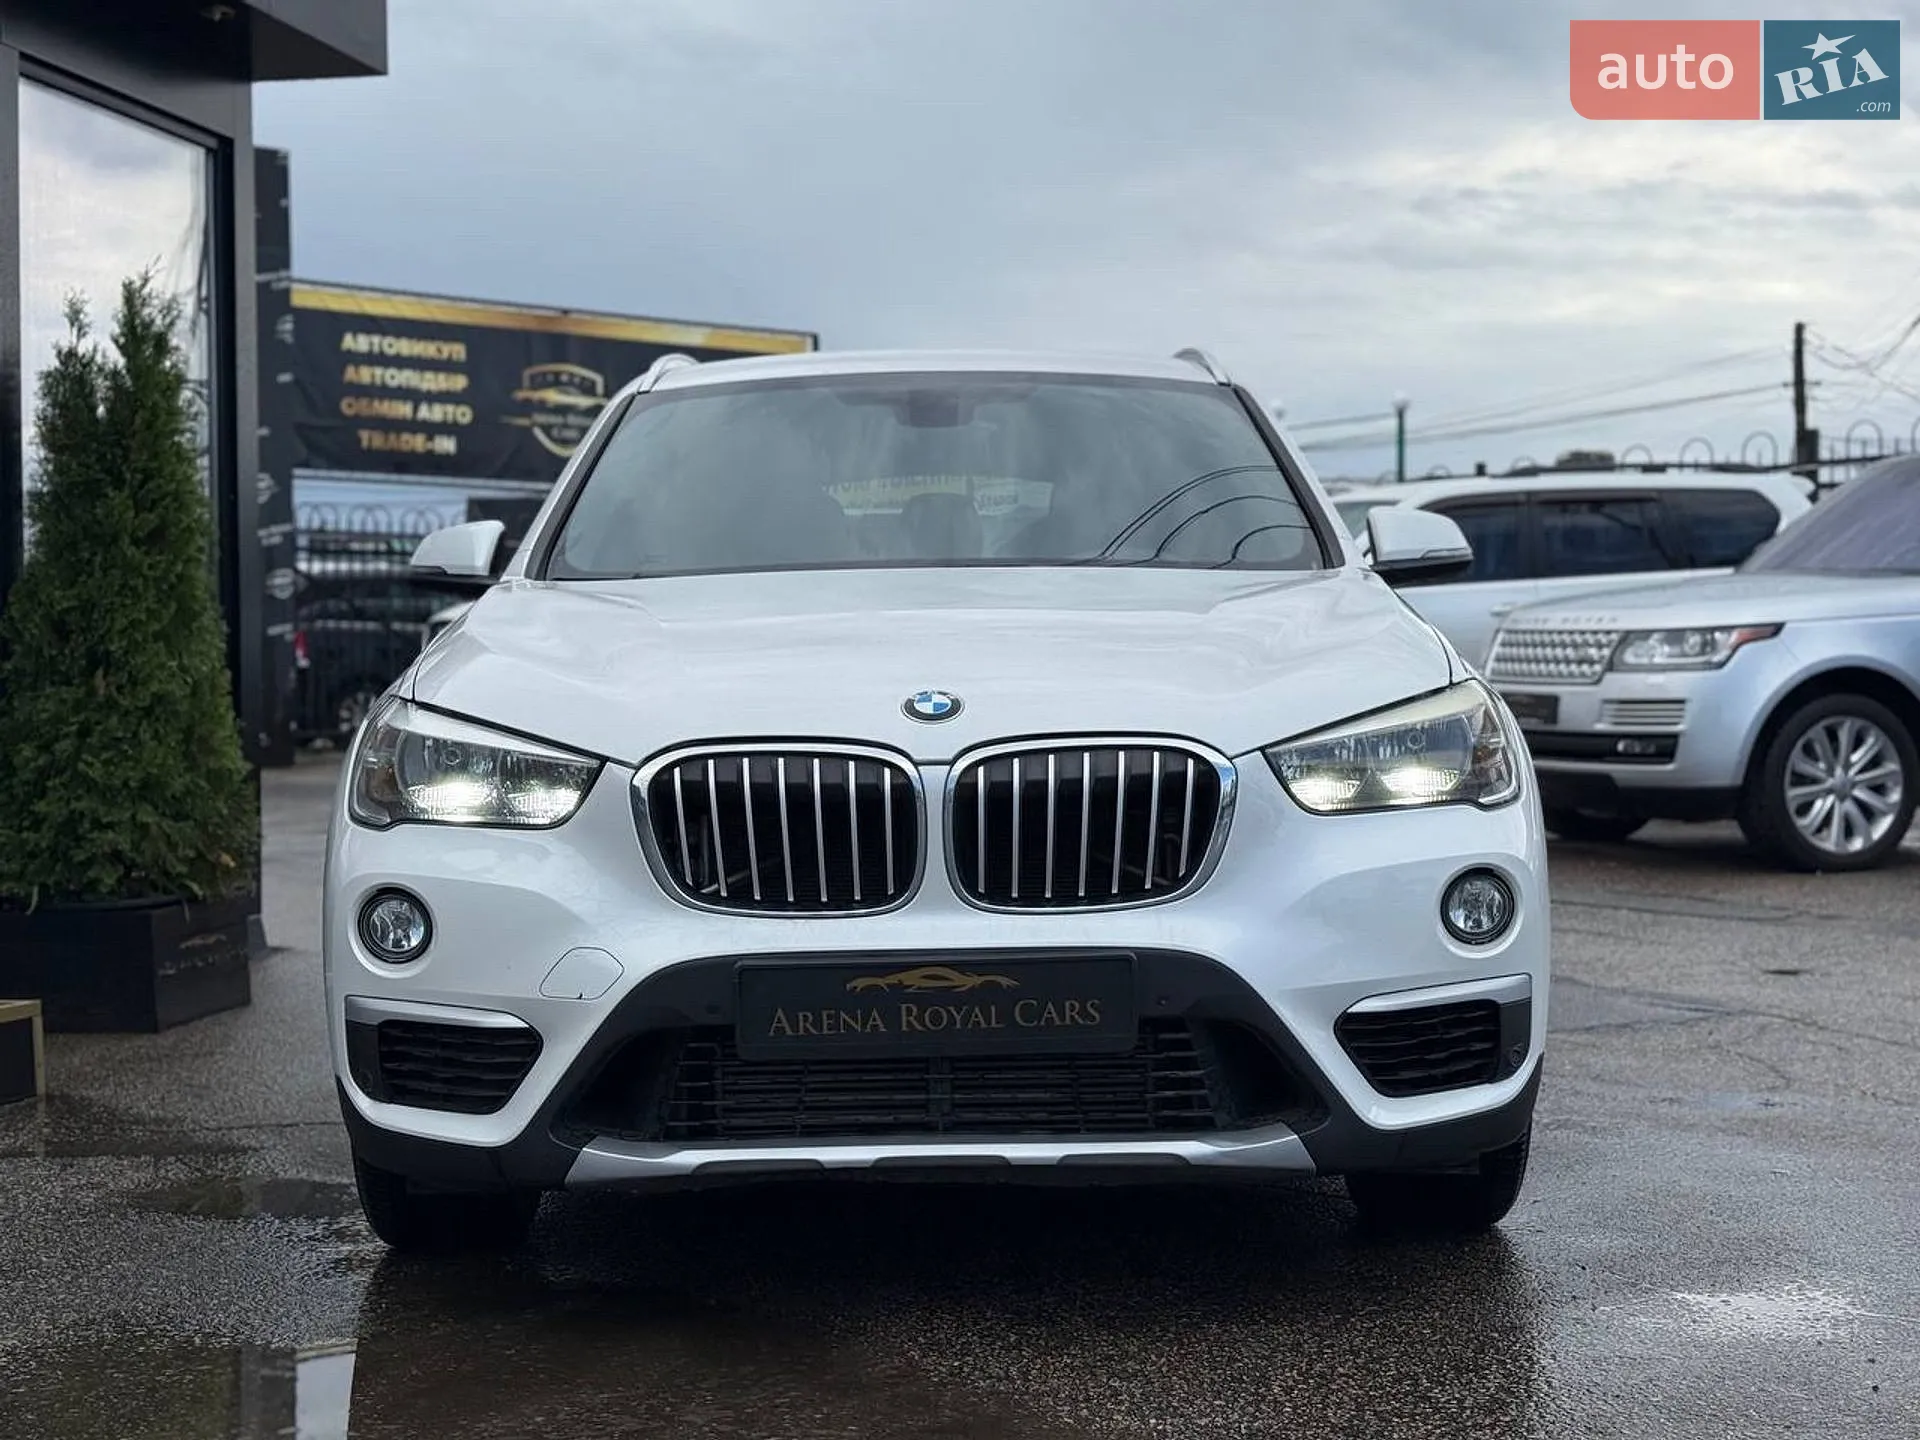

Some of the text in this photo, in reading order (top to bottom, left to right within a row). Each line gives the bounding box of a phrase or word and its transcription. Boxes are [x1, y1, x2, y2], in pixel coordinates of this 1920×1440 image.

[340, 331, 467, 362] АВТОВИКУП
[340, 396, 474, 426] ОБМІН АВТО
[357, 429, 458, 456] TRADE-IN
[768, 999, 1102, 1036] ARENA ROYAL CARS
